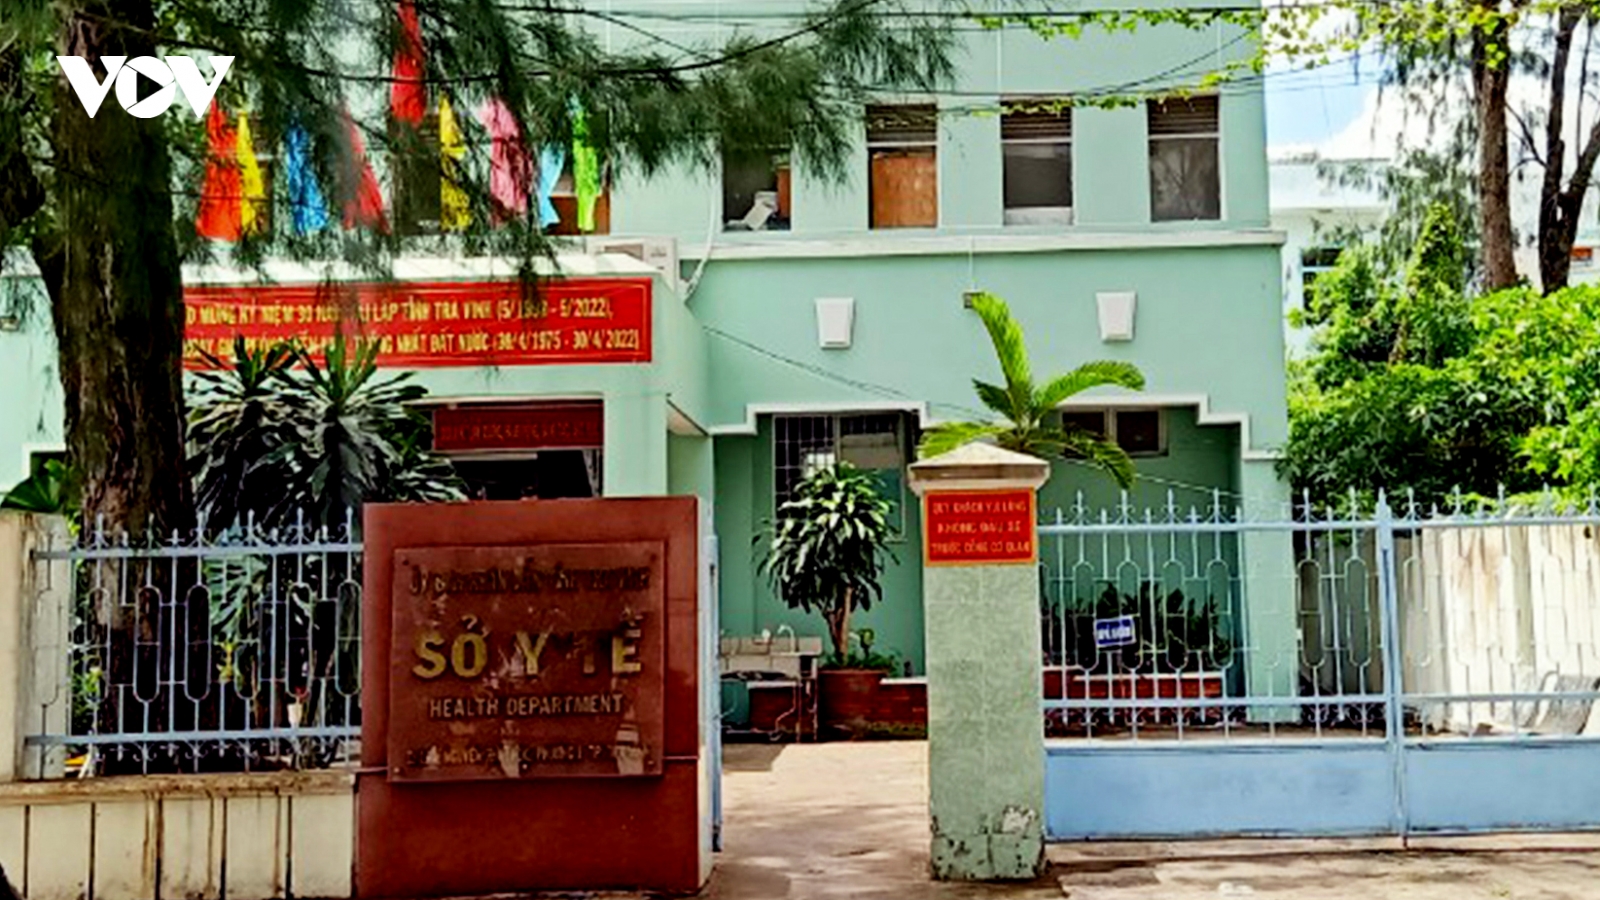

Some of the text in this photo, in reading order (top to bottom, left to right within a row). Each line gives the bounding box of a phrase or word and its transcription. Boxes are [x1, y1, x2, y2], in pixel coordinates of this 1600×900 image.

[464, 301, 492, 321] VINH
[411, 613, 492, 679] SỞ
[515, 628, 554, 675] Y
[429, 693, 625, 719] HEALTH DEPARTMENT
